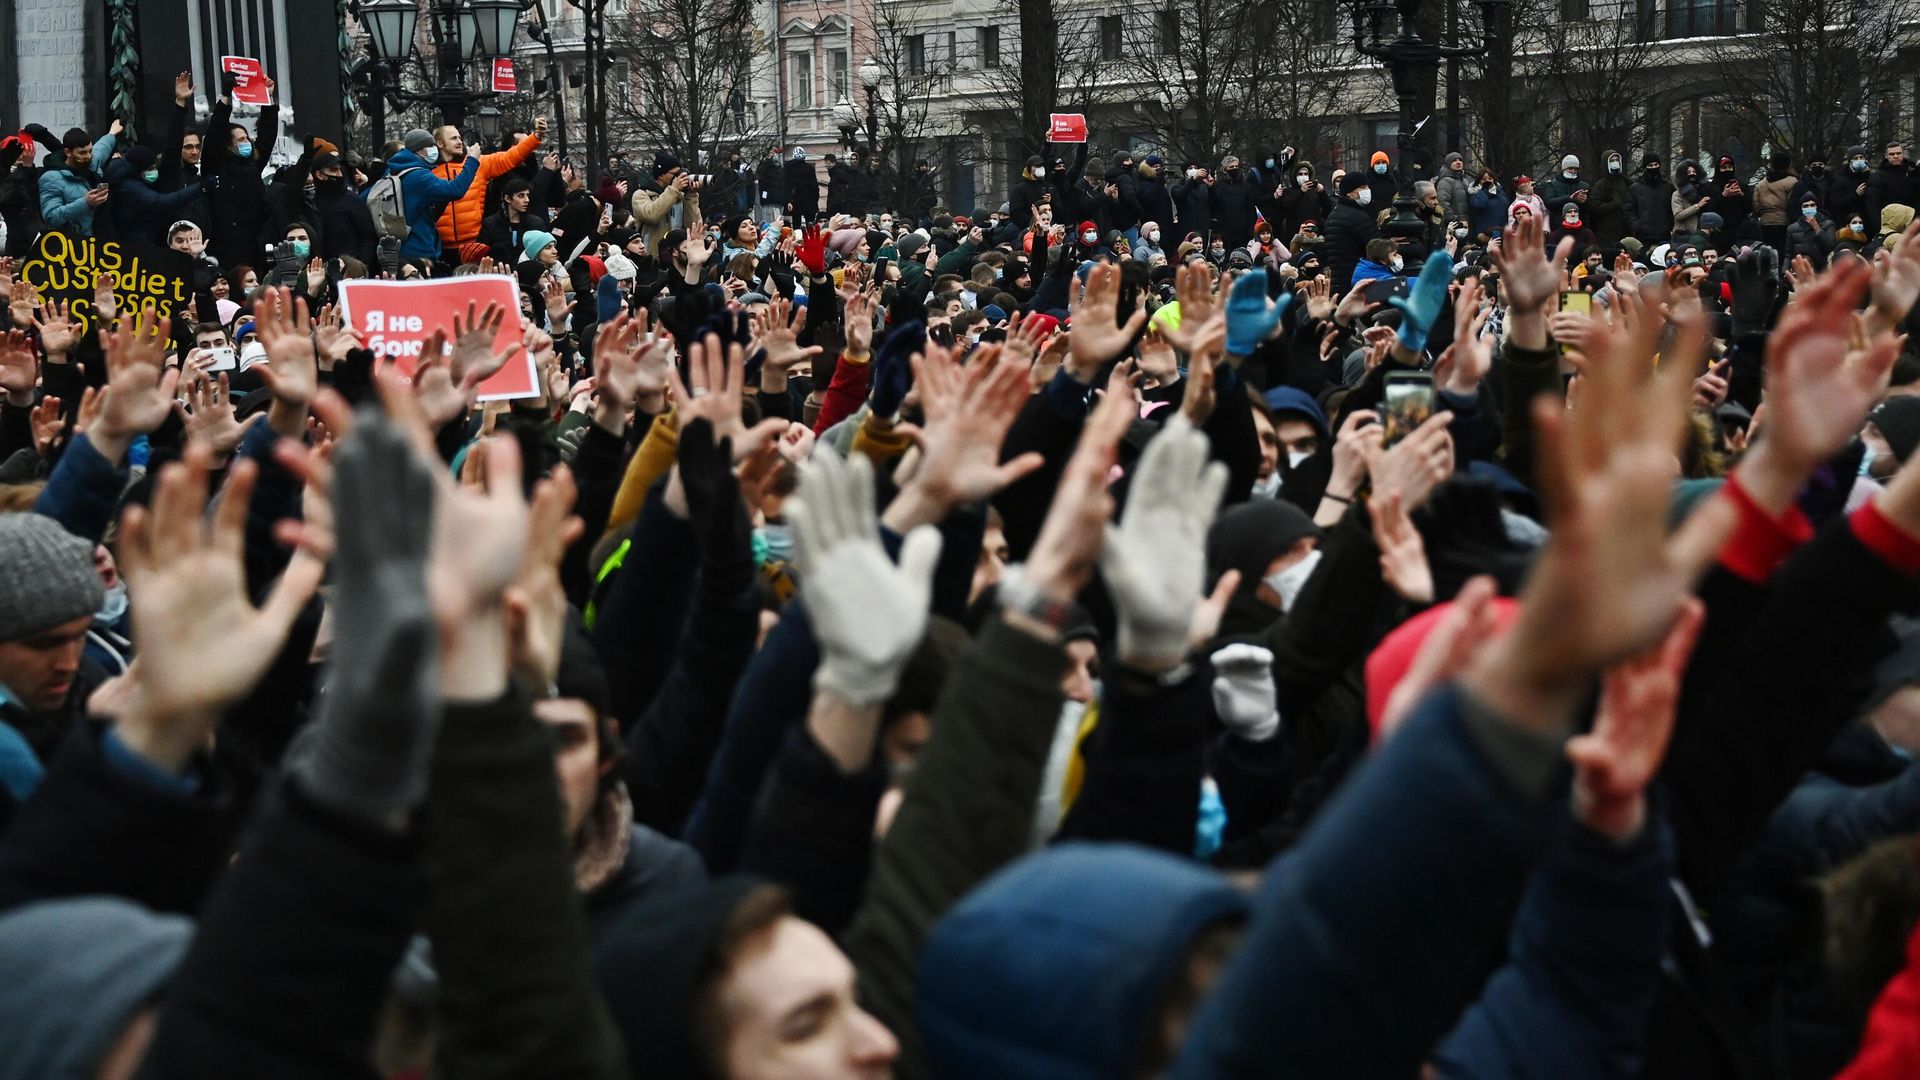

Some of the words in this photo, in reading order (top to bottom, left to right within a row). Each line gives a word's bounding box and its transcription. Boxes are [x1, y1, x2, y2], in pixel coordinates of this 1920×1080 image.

[41, 231, 122, 270] Quis
[365, 310, 385, 332] Я
[389, 315, 423, 333] не
[367, 335, 454, 358] боюь
